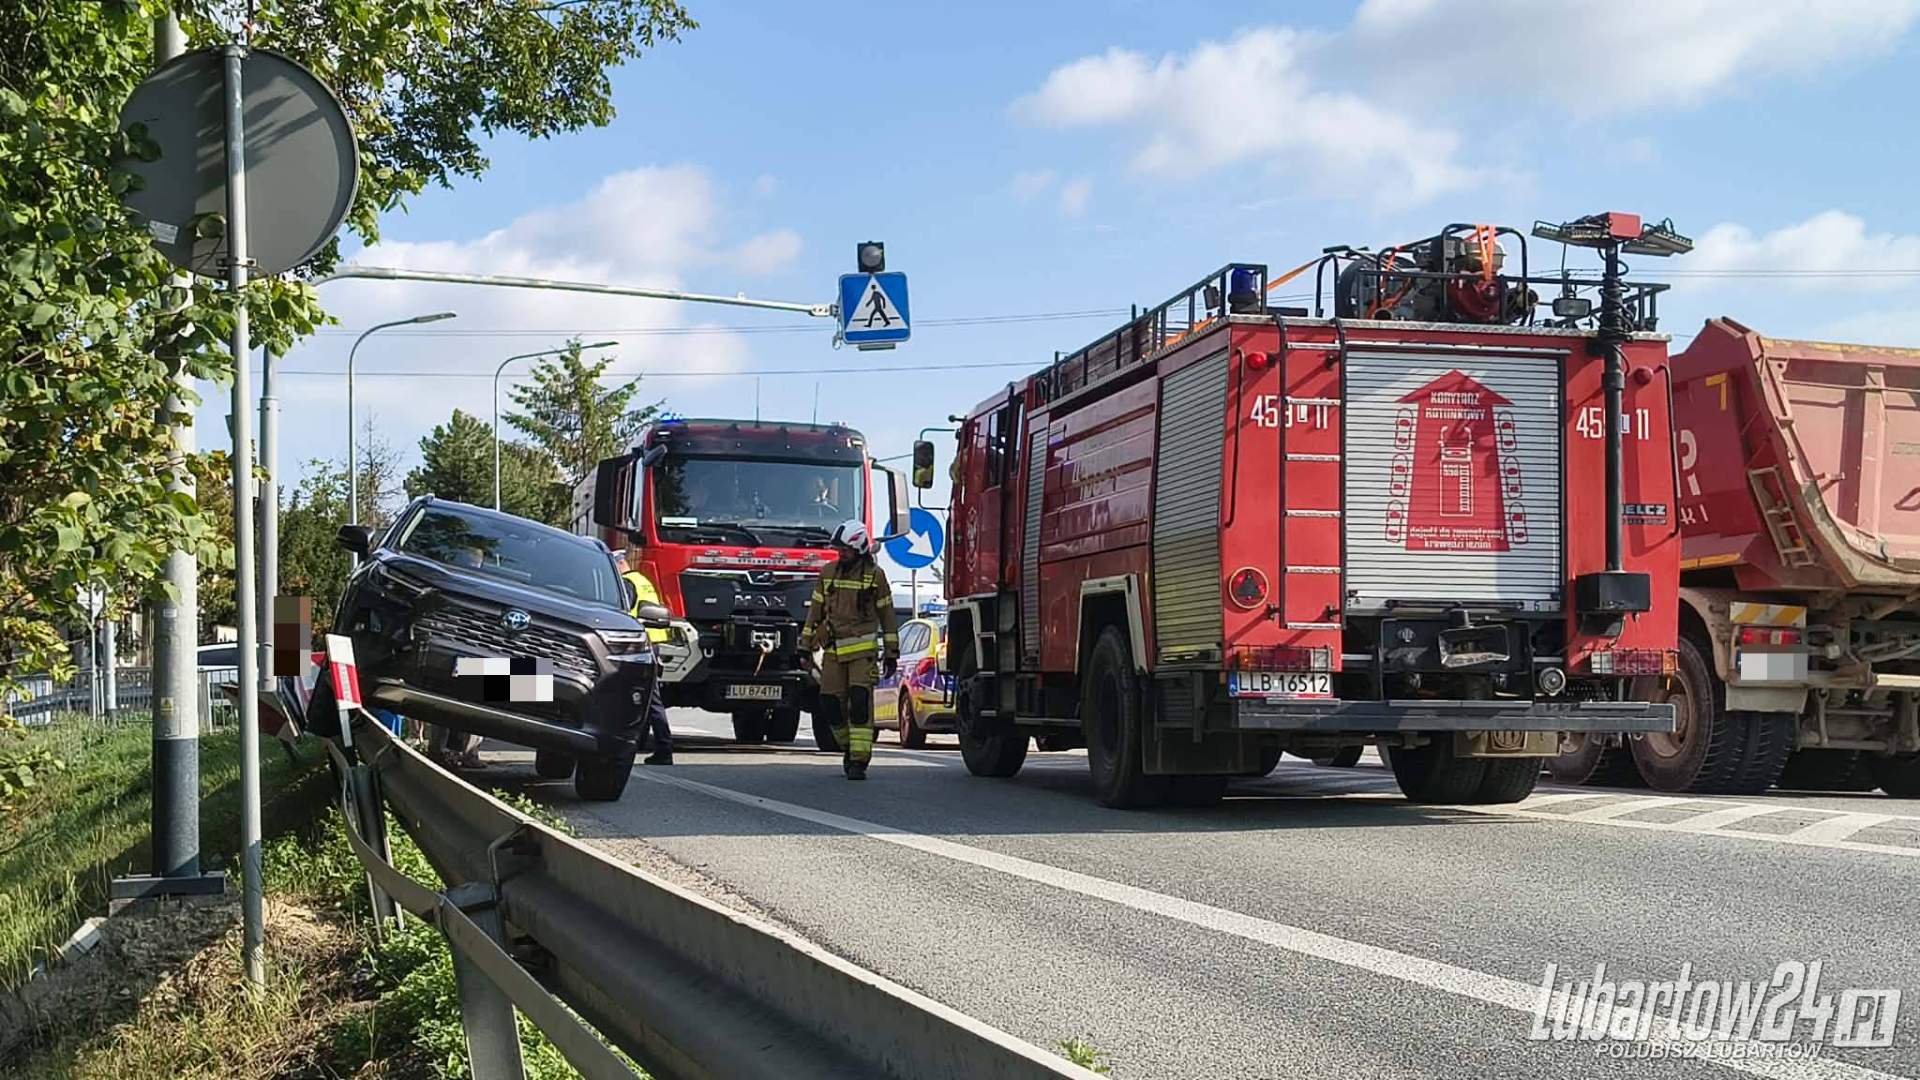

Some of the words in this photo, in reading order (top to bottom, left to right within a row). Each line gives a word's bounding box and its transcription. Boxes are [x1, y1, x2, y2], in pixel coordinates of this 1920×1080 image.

[1621, 504, 1666, 516] ELCZ
[1239, 672, 1272, 692] LLB
[1278, 674, 1329, 693] 16512
